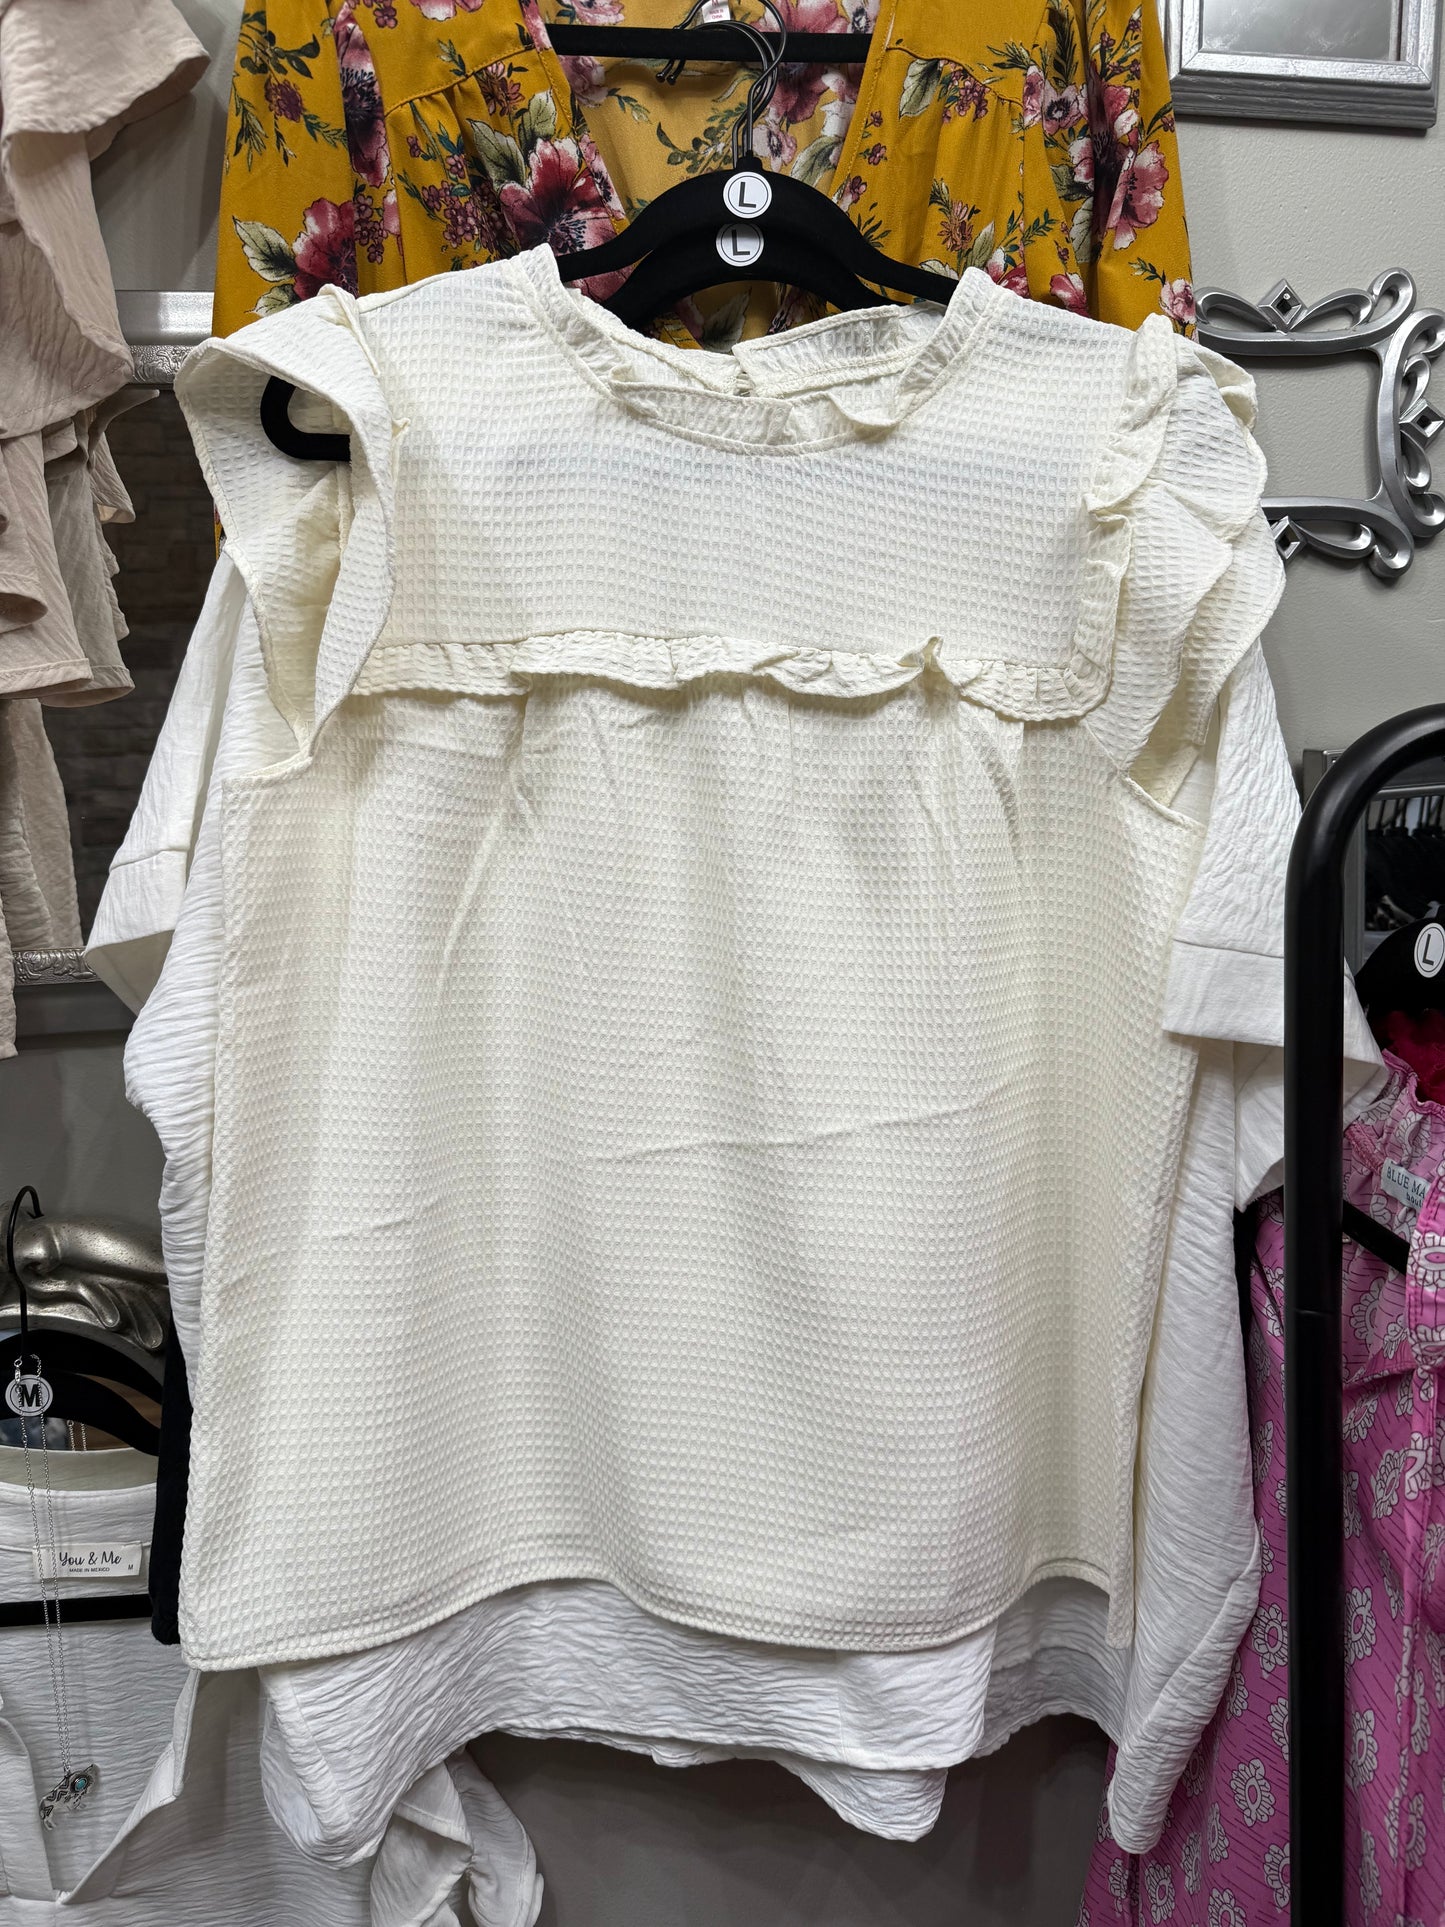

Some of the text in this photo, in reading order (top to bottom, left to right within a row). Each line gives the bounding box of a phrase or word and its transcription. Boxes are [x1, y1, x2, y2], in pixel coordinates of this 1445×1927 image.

[738, 181, 757, 208] L
[731, 229, 751, 256] L
[1422, 933, 1435, 966] L
[1386, 1165, 1410, 1190] BLUE
[18, 1383, 42, 1408] M
[59, 1550, 122, 1567] You & Me
